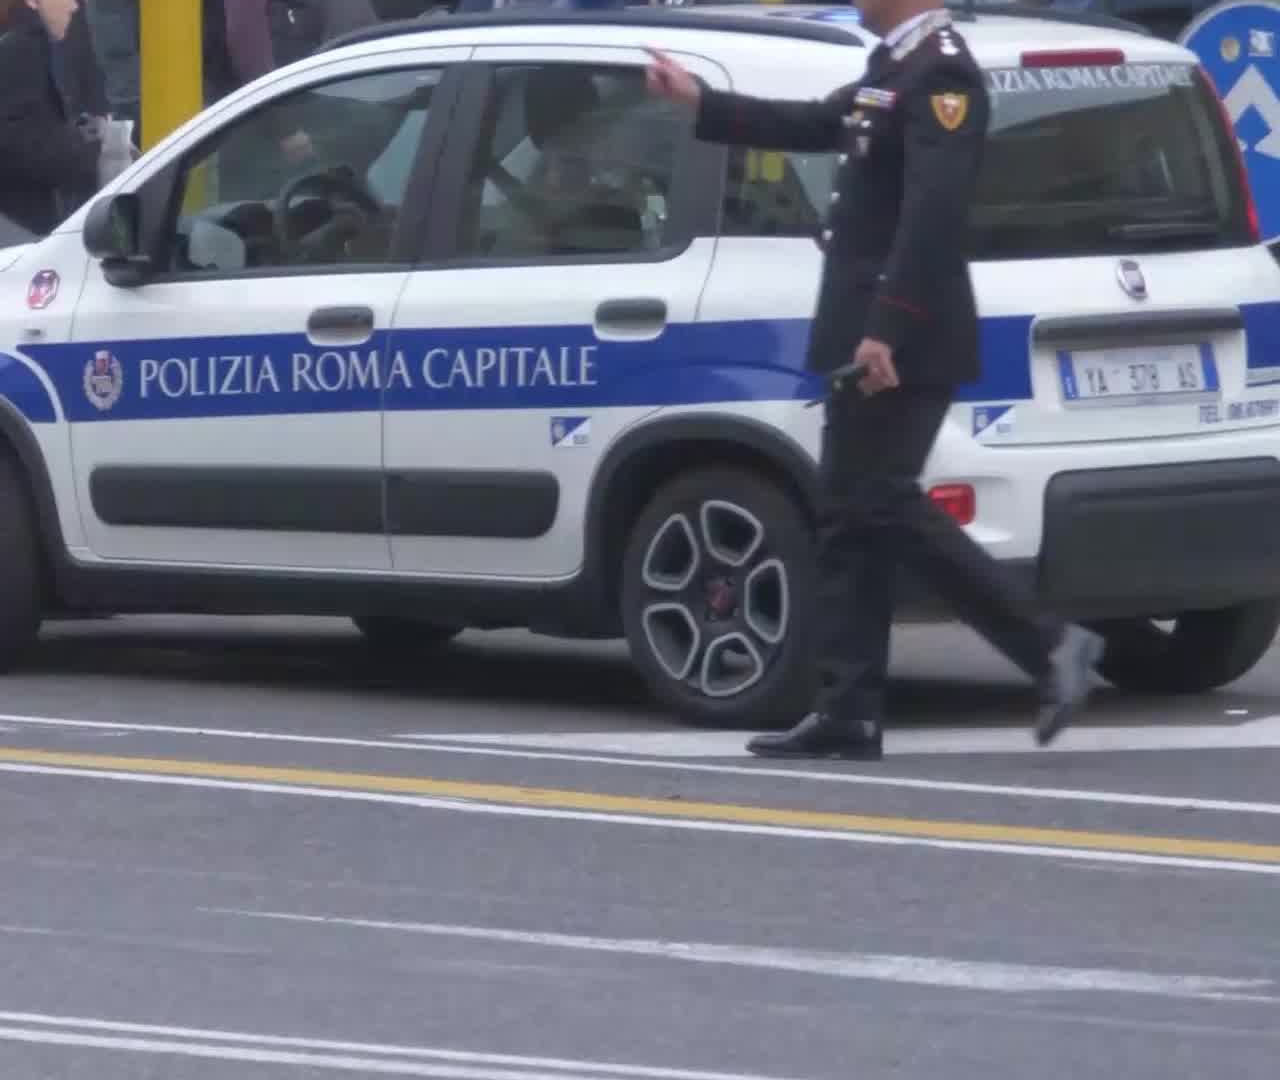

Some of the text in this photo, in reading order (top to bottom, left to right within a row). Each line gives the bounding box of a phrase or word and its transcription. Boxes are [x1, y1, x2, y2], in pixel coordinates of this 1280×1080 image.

[1041, 67, 1111, 91] ROMA
[140, 344, 598, 399] POLIZIA ROMA CAPITALE
